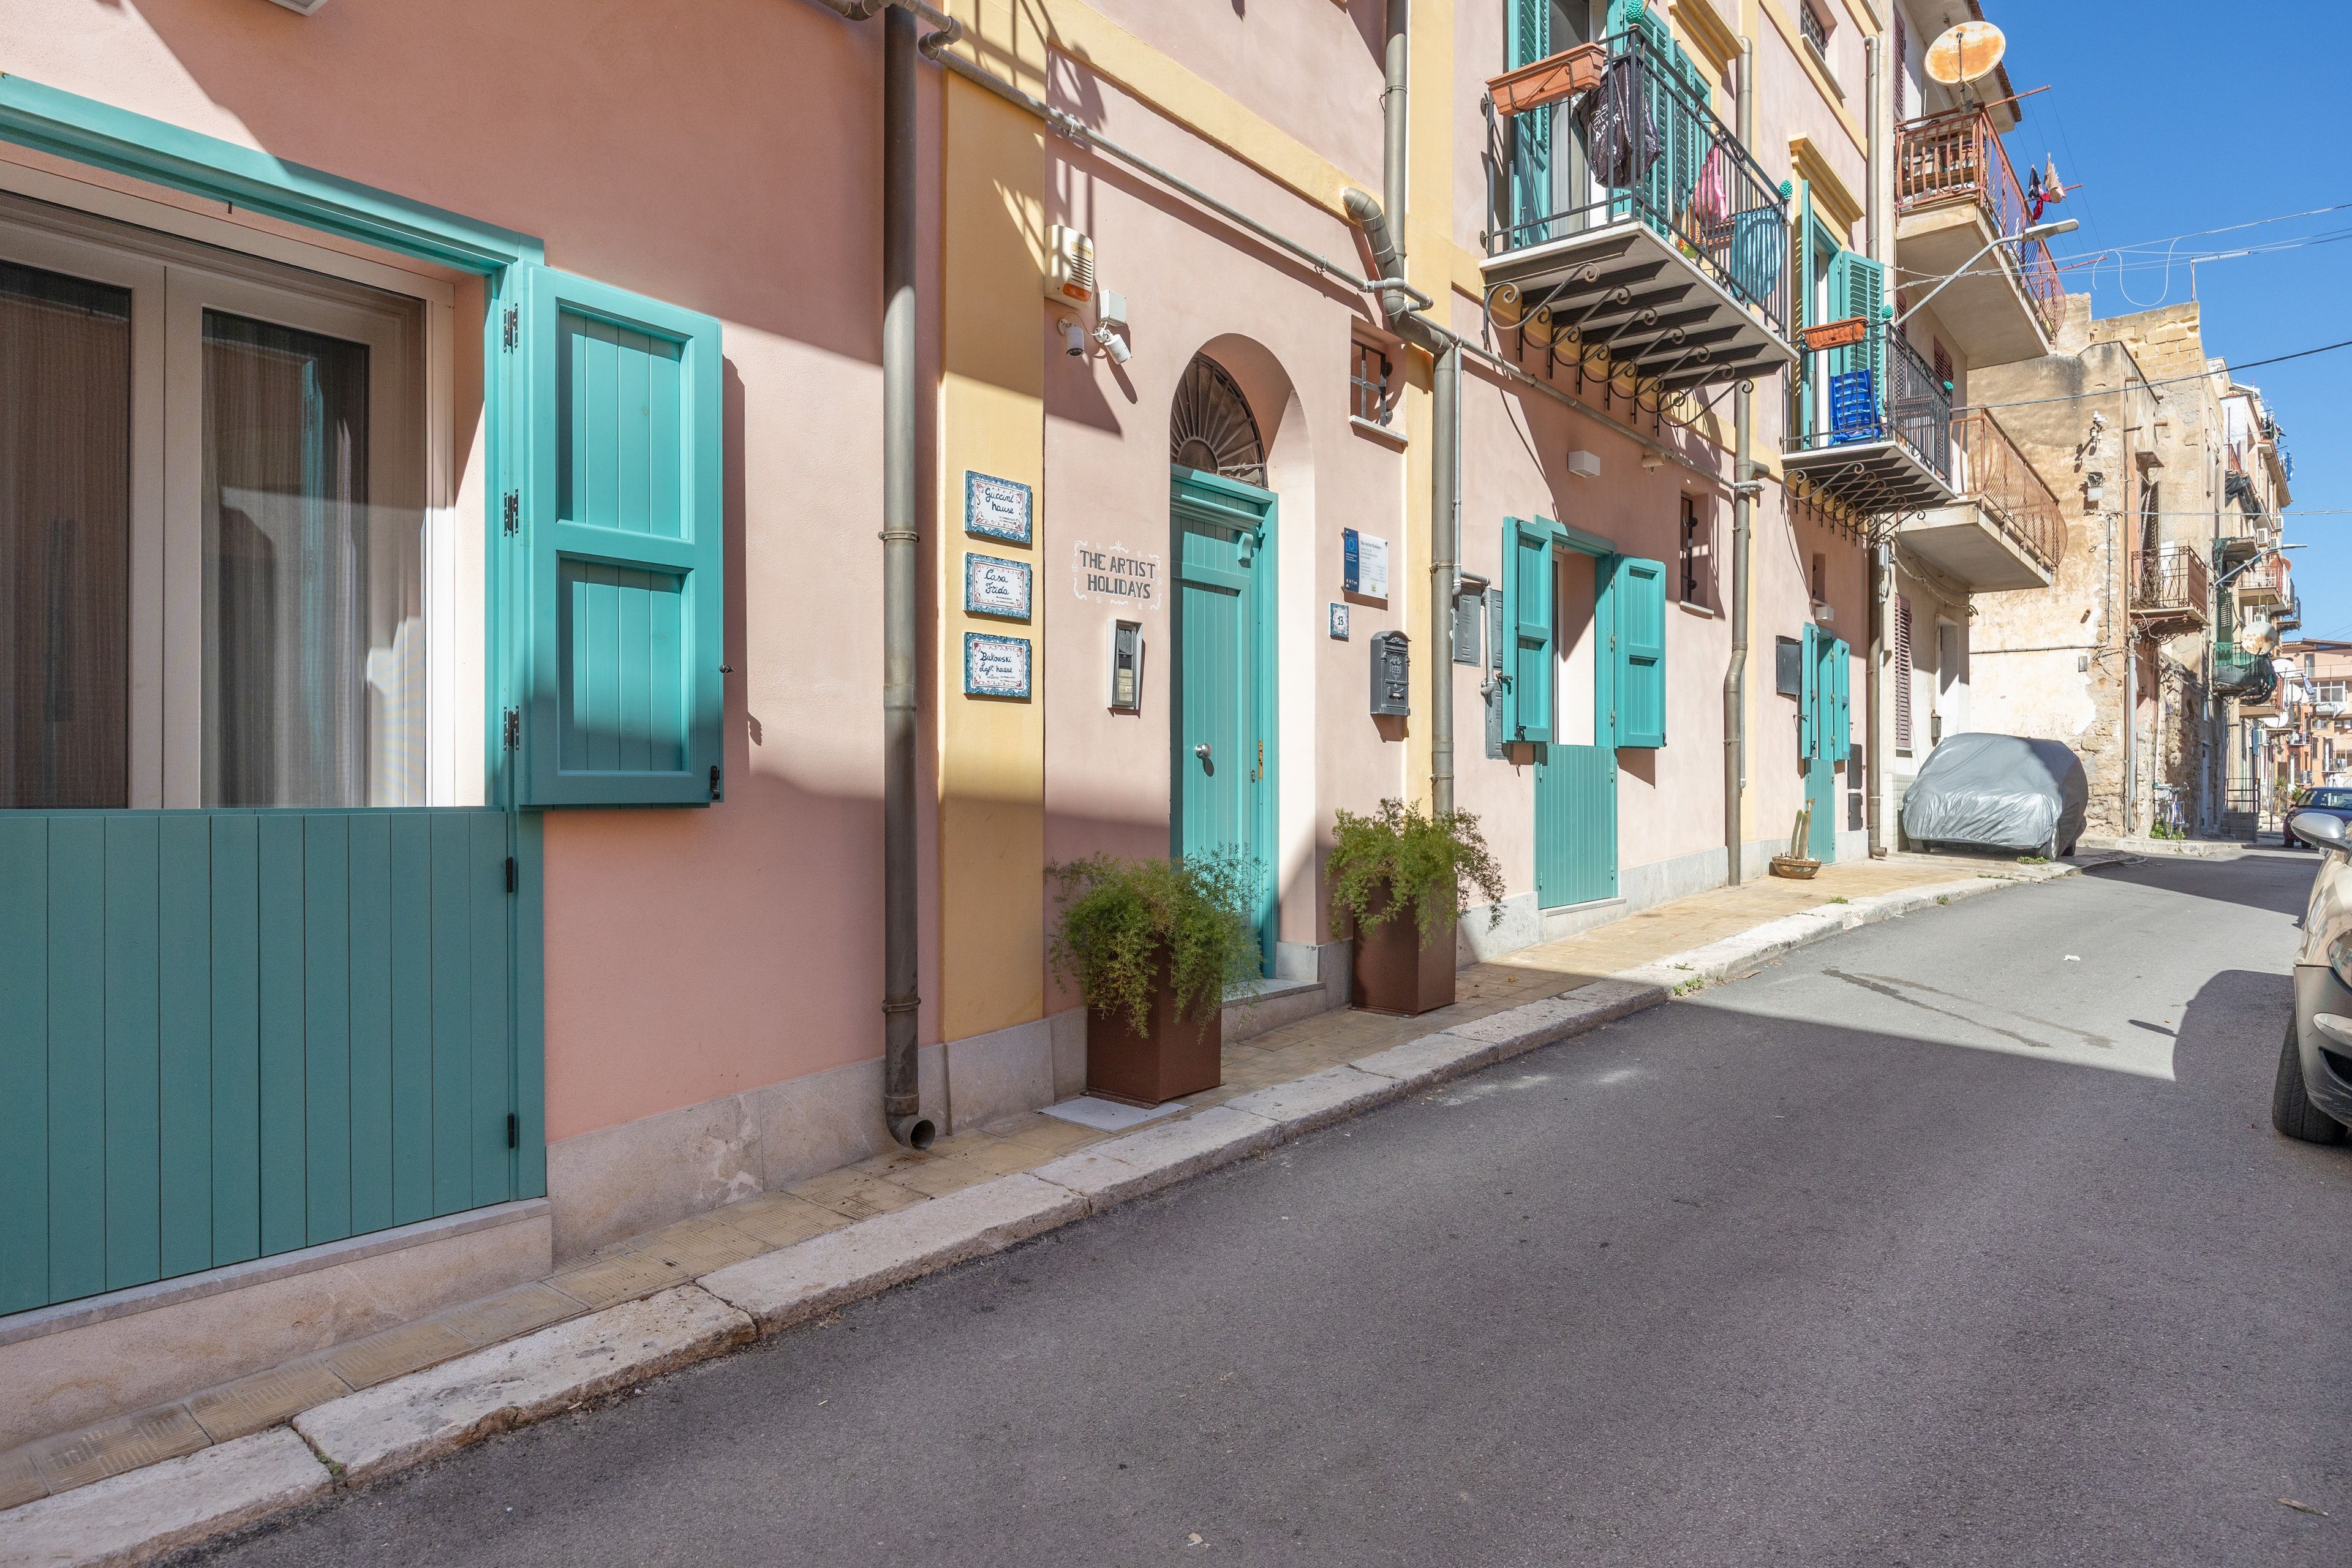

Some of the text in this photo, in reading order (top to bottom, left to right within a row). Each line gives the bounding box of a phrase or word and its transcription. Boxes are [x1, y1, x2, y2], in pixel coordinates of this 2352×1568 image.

[985, 488, 1014, 503] Guccini
[1080, 550, 1155, 579] THE ARTIST
[984, 569, 1008, 582] Casa
[986, 582, 1009, 595] Frida
[1087, 573, 1151, 599] HOLIDAYS
[1337, 615, 1344, 625] 13
[979, 650, 1012, 663] Bukowski
[979, 662, 994, 676] Loft
